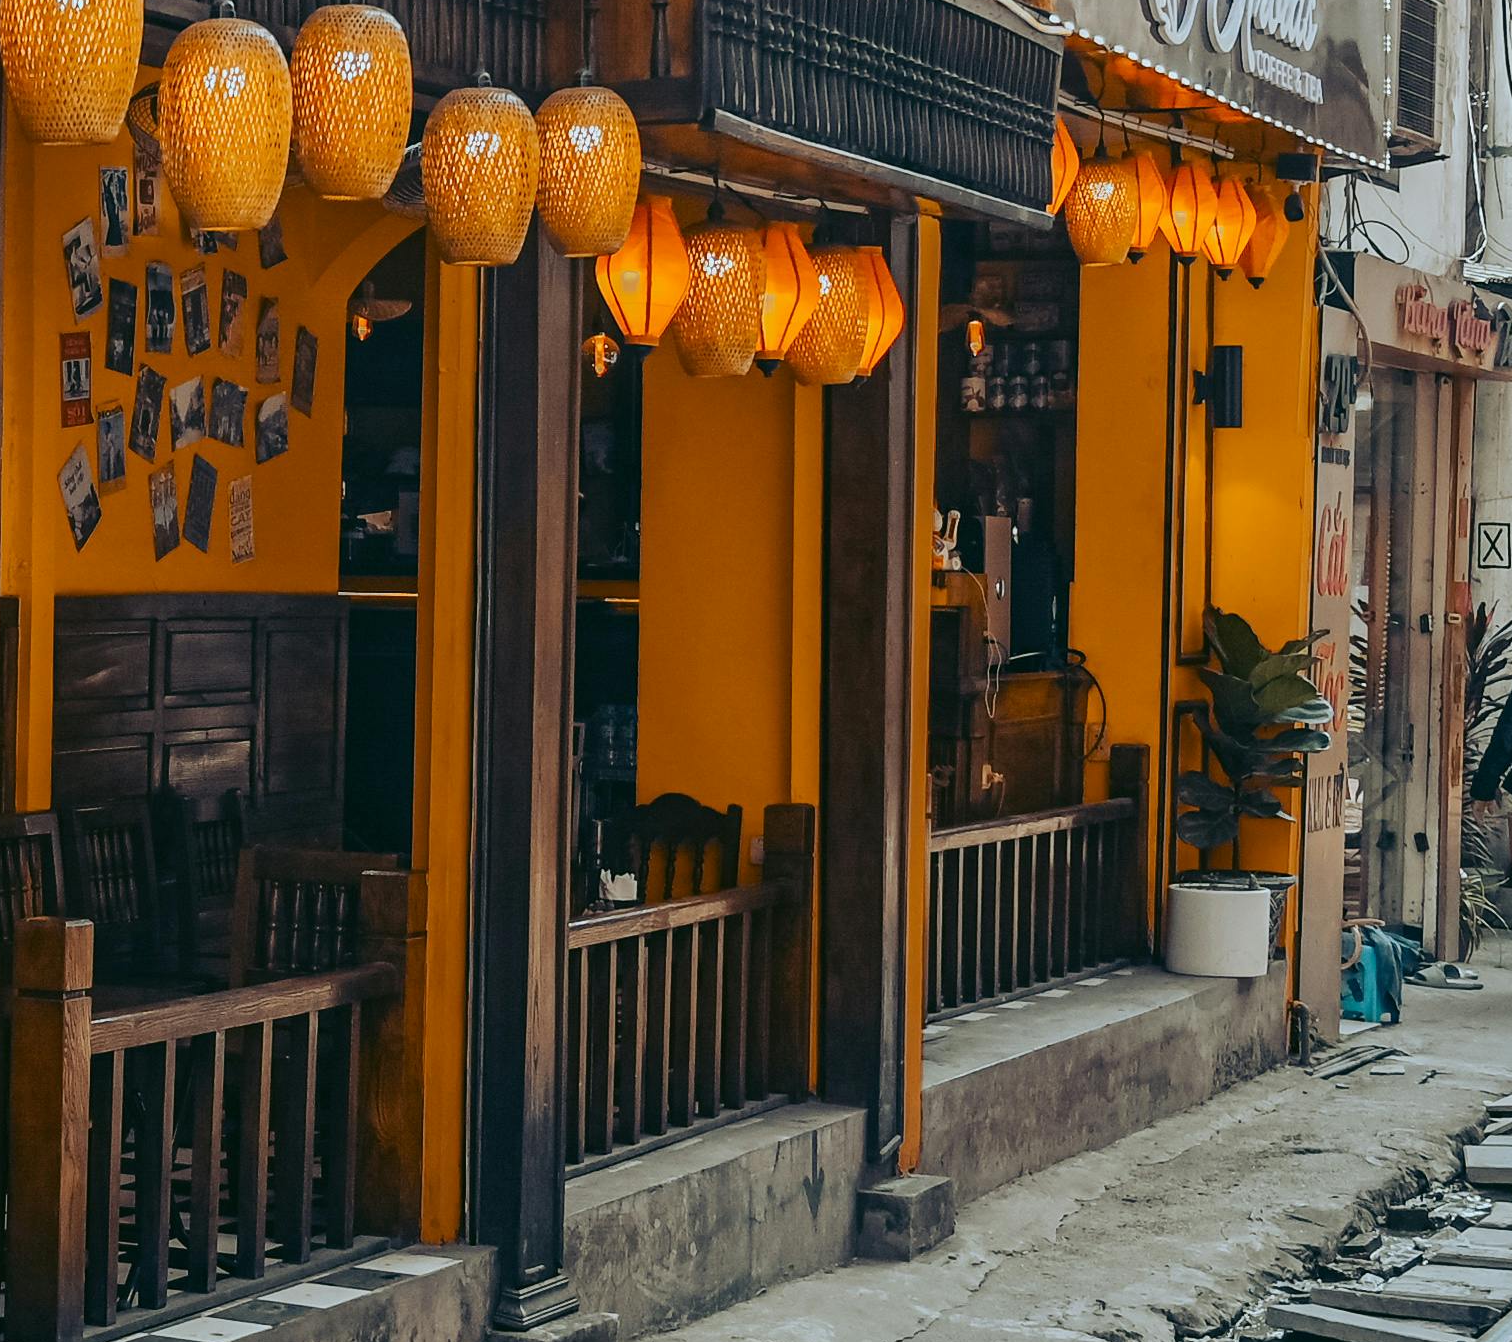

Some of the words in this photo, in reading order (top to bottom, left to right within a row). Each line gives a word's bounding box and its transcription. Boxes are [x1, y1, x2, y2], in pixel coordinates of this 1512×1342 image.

[1255, 50, 1294, 92] COFFEE
[1301, 72, 1323, 104] TEA
[1316, 491, 1348, 597] Cắt
